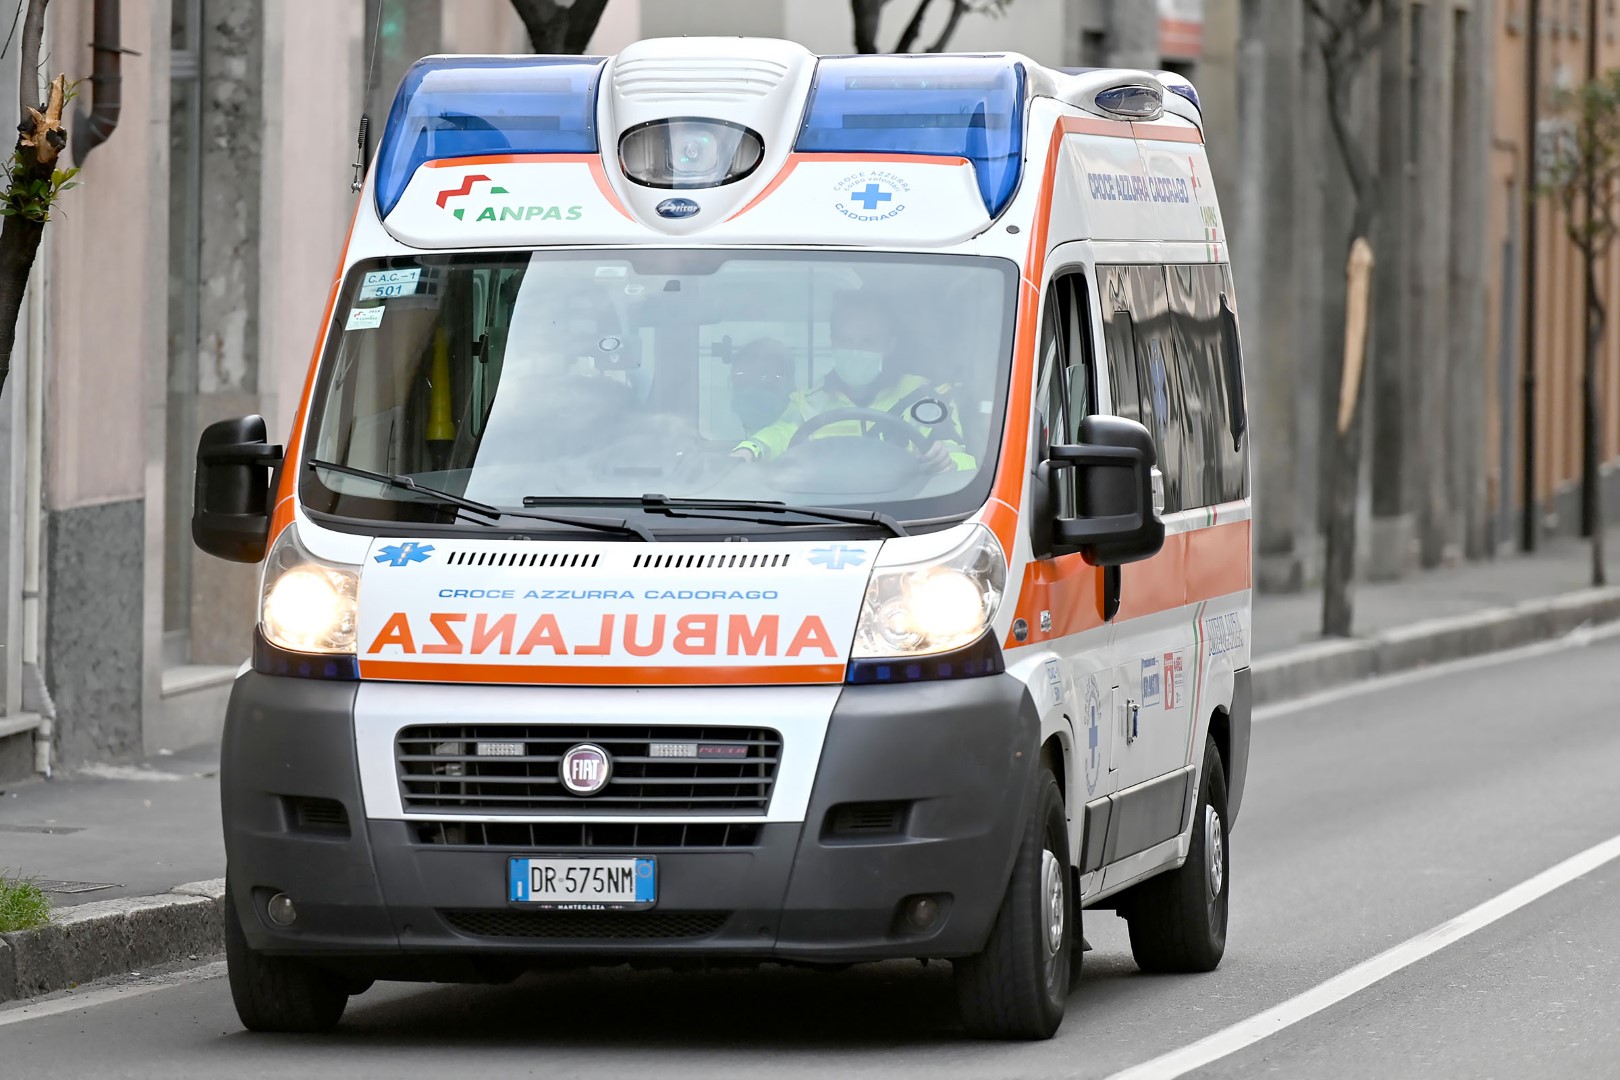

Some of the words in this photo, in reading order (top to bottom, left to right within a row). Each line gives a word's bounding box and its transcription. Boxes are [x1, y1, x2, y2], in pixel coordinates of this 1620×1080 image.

[833, 171, 866, 191] CROCE
[870, 171, 911, 192] AZZURRA
[844, 178, 866, 191] corpo
[1088, 173, 1116, 200] CROCE
[1115, 174, 1150, 202] AZZURRA
[1148, 177, 1189, 203] CADORAGO
[476, 206, 583, 221] ANPAS
[835, 203, 905, 221] CADORAGO
[375, 285, 402, 297] 501
[438, 589, 515, 598] CROCE
[523, 590, 635, 599] AZZURRA
[644, 590, 779, 600] CADORAGO
[572, 759, 600, 780] FIAT
[531, 866, 557, 893] DR
[565, 867, 634, 894] 575NM
